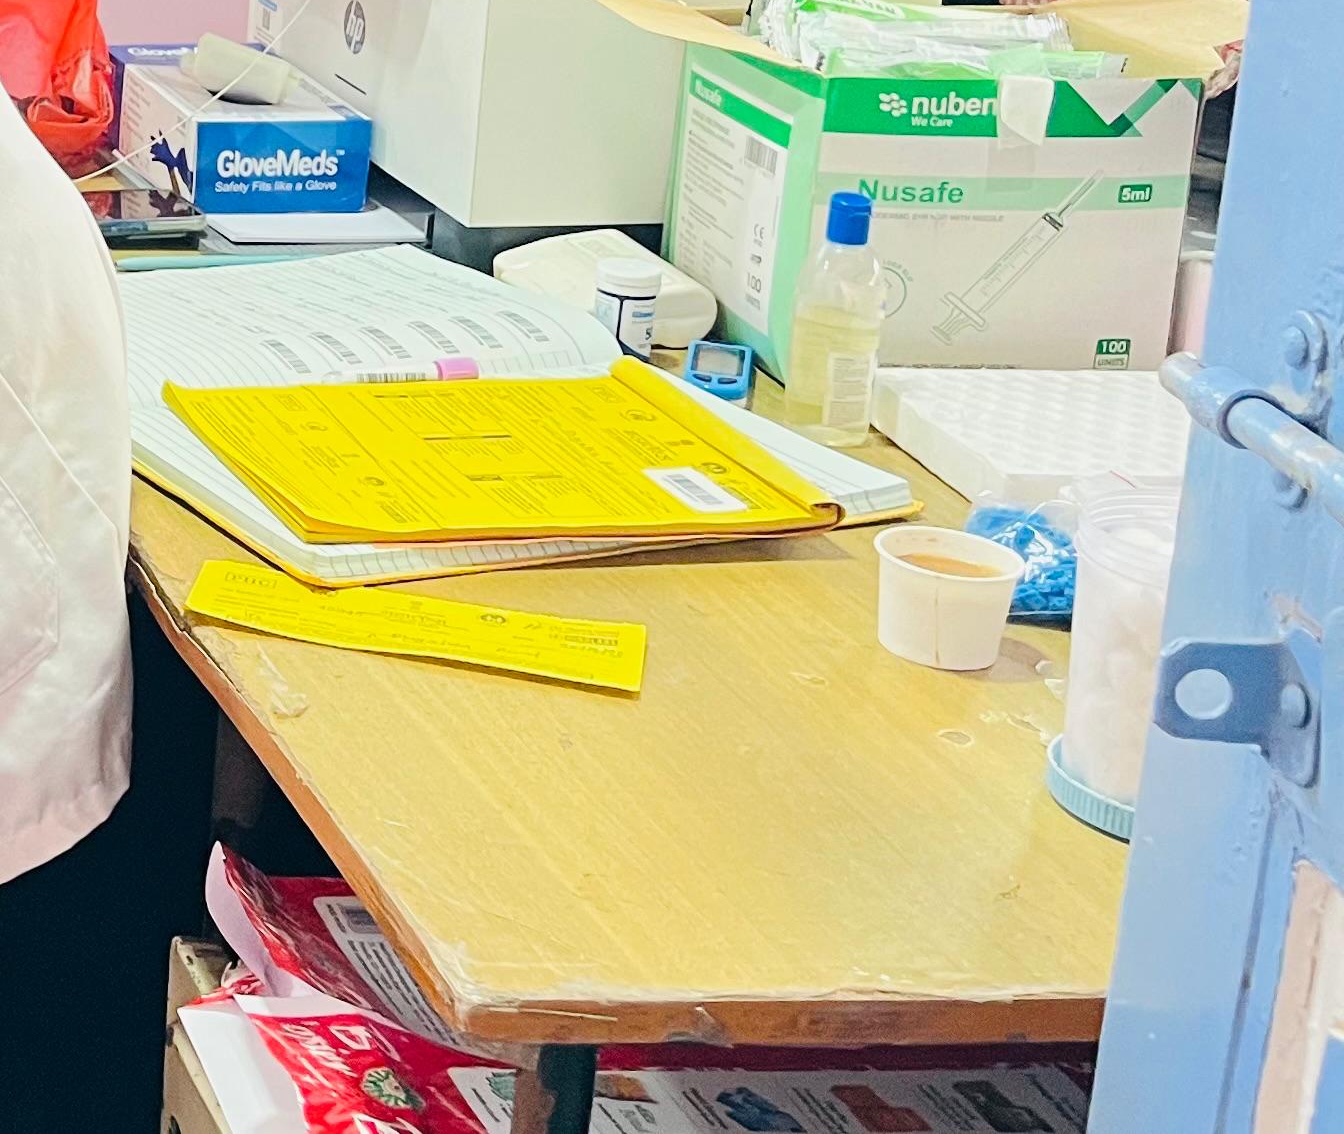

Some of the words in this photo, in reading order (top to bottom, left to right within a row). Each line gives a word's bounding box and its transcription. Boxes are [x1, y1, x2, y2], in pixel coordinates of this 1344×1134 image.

[344, 0, 365, 54] hp
[912, 117, 928, 127] We
[930, 117, 953, 127] Care
[215, 181, 249, 194] Safety
[274, 181, 293, 191] like
[305, 180, 337, 191] Glove
[858, 179, 964, 203] Nusafe
[1121, 187, 1150, 201] 5ml
[1100, 341, 1127, 354] 100
